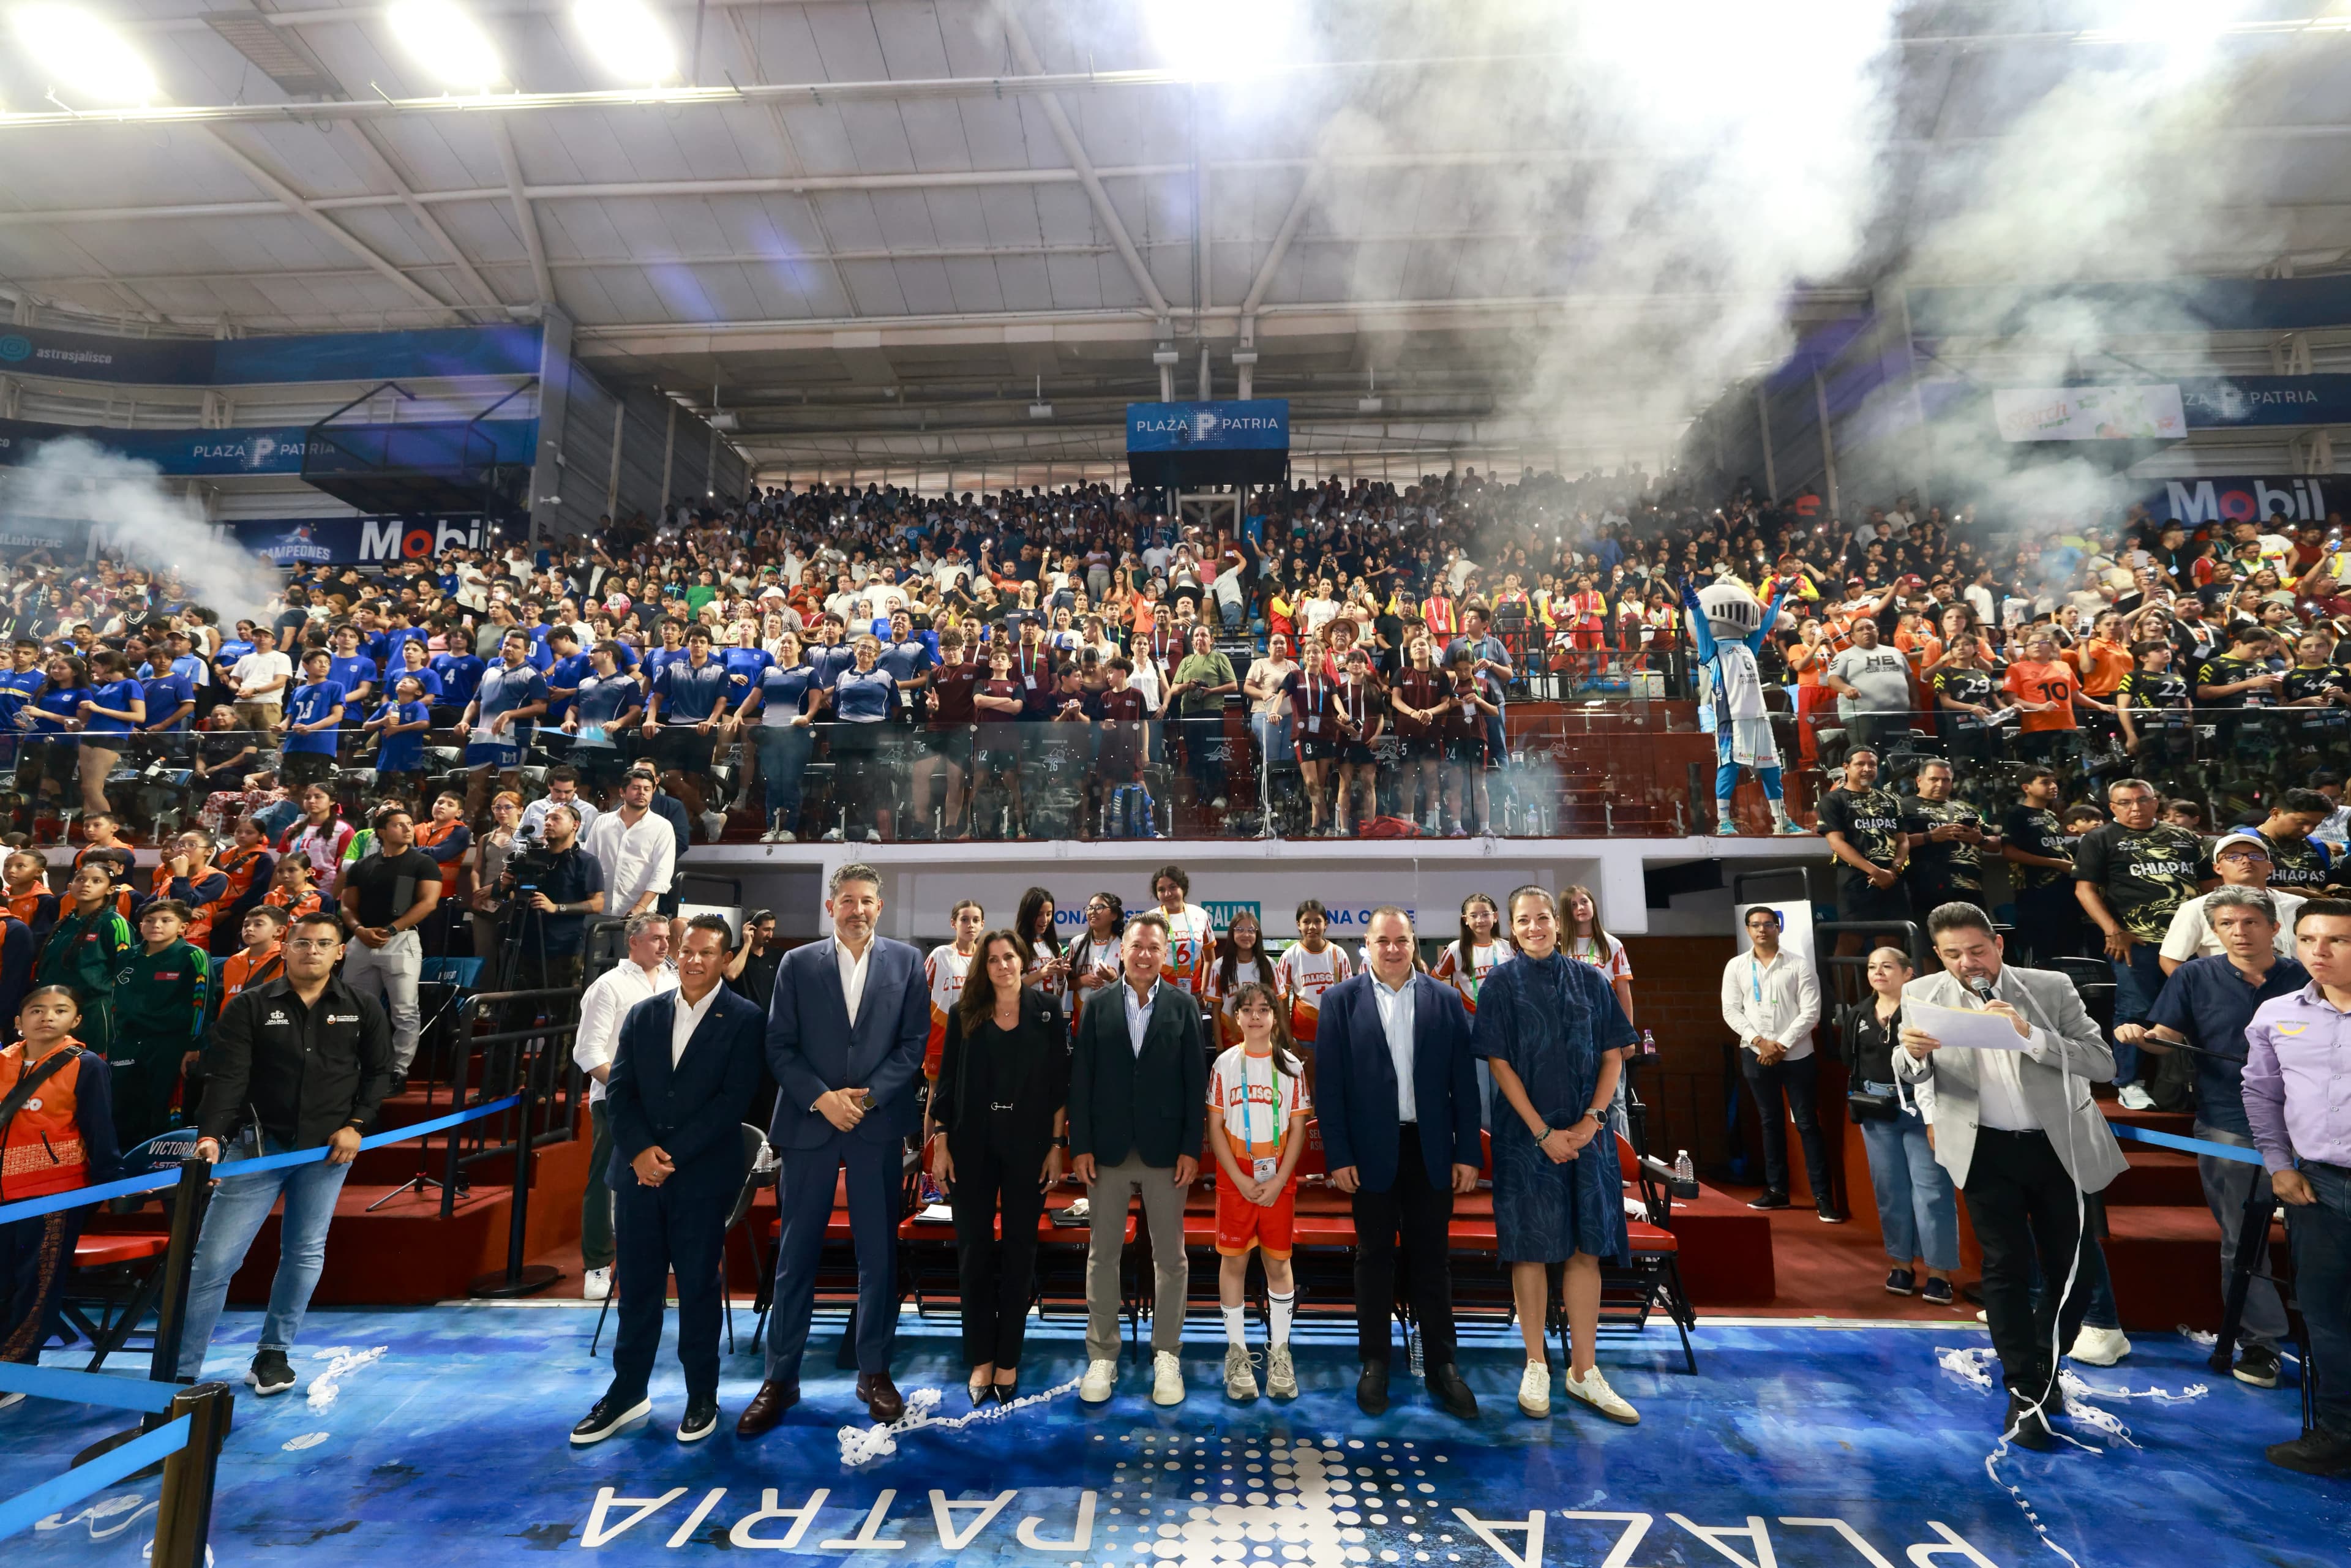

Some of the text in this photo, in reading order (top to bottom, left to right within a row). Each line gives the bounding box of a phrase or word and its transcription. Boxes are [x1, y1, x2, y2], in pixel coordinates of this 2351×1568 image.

[37, 348, 113, 364] astrosjalisco
[2249, 390, 2318, 404] PATRIA
[1137, 419, 1188, 432] PLAZA
[1222, 418, 1278, 430] PATRIA
[193, 445, 246, 457] PLAZA
[280, 443, 336, 456] PATRIA
[2166, 479, 2325, 523] Mobil
[359, 519, 492, 560] Mobil
[260, 544, 331, 561] CAMPEONES
[529, 641, 538, 658] 0
[1866, 655, 1896, 666] HB
[444, 669, 456, 685] 4
[2303, 679, 2333, 689] 44
[1966, 678, 1990, 693] 29
[2037, 681, 2069, 701] 10
[2158, 681, 2187, 697] 22
[978, 749, 988, 762] 12
[1305, 743, 1313, 754] 8
[1445, 747, 1456, 760] 24
[1049, 759, 1058, 771] 26
[2129, 861, 2194, 877] CHIAPAS
[2266, 869, 2325, 882] CHIAPAS
[1054, 910, 1088, 925] ON
[1327, 910, 1353, 925] NA
[1177, 943, 1191, 964] 6
[1301, 972, 1334, 988] JALISC
[148, 1141, 197, 1156] VICTORIA
[579, 1487, 1098, 1552] PATRIA
[1452, 1507, 2001, 1568] PLAZA
